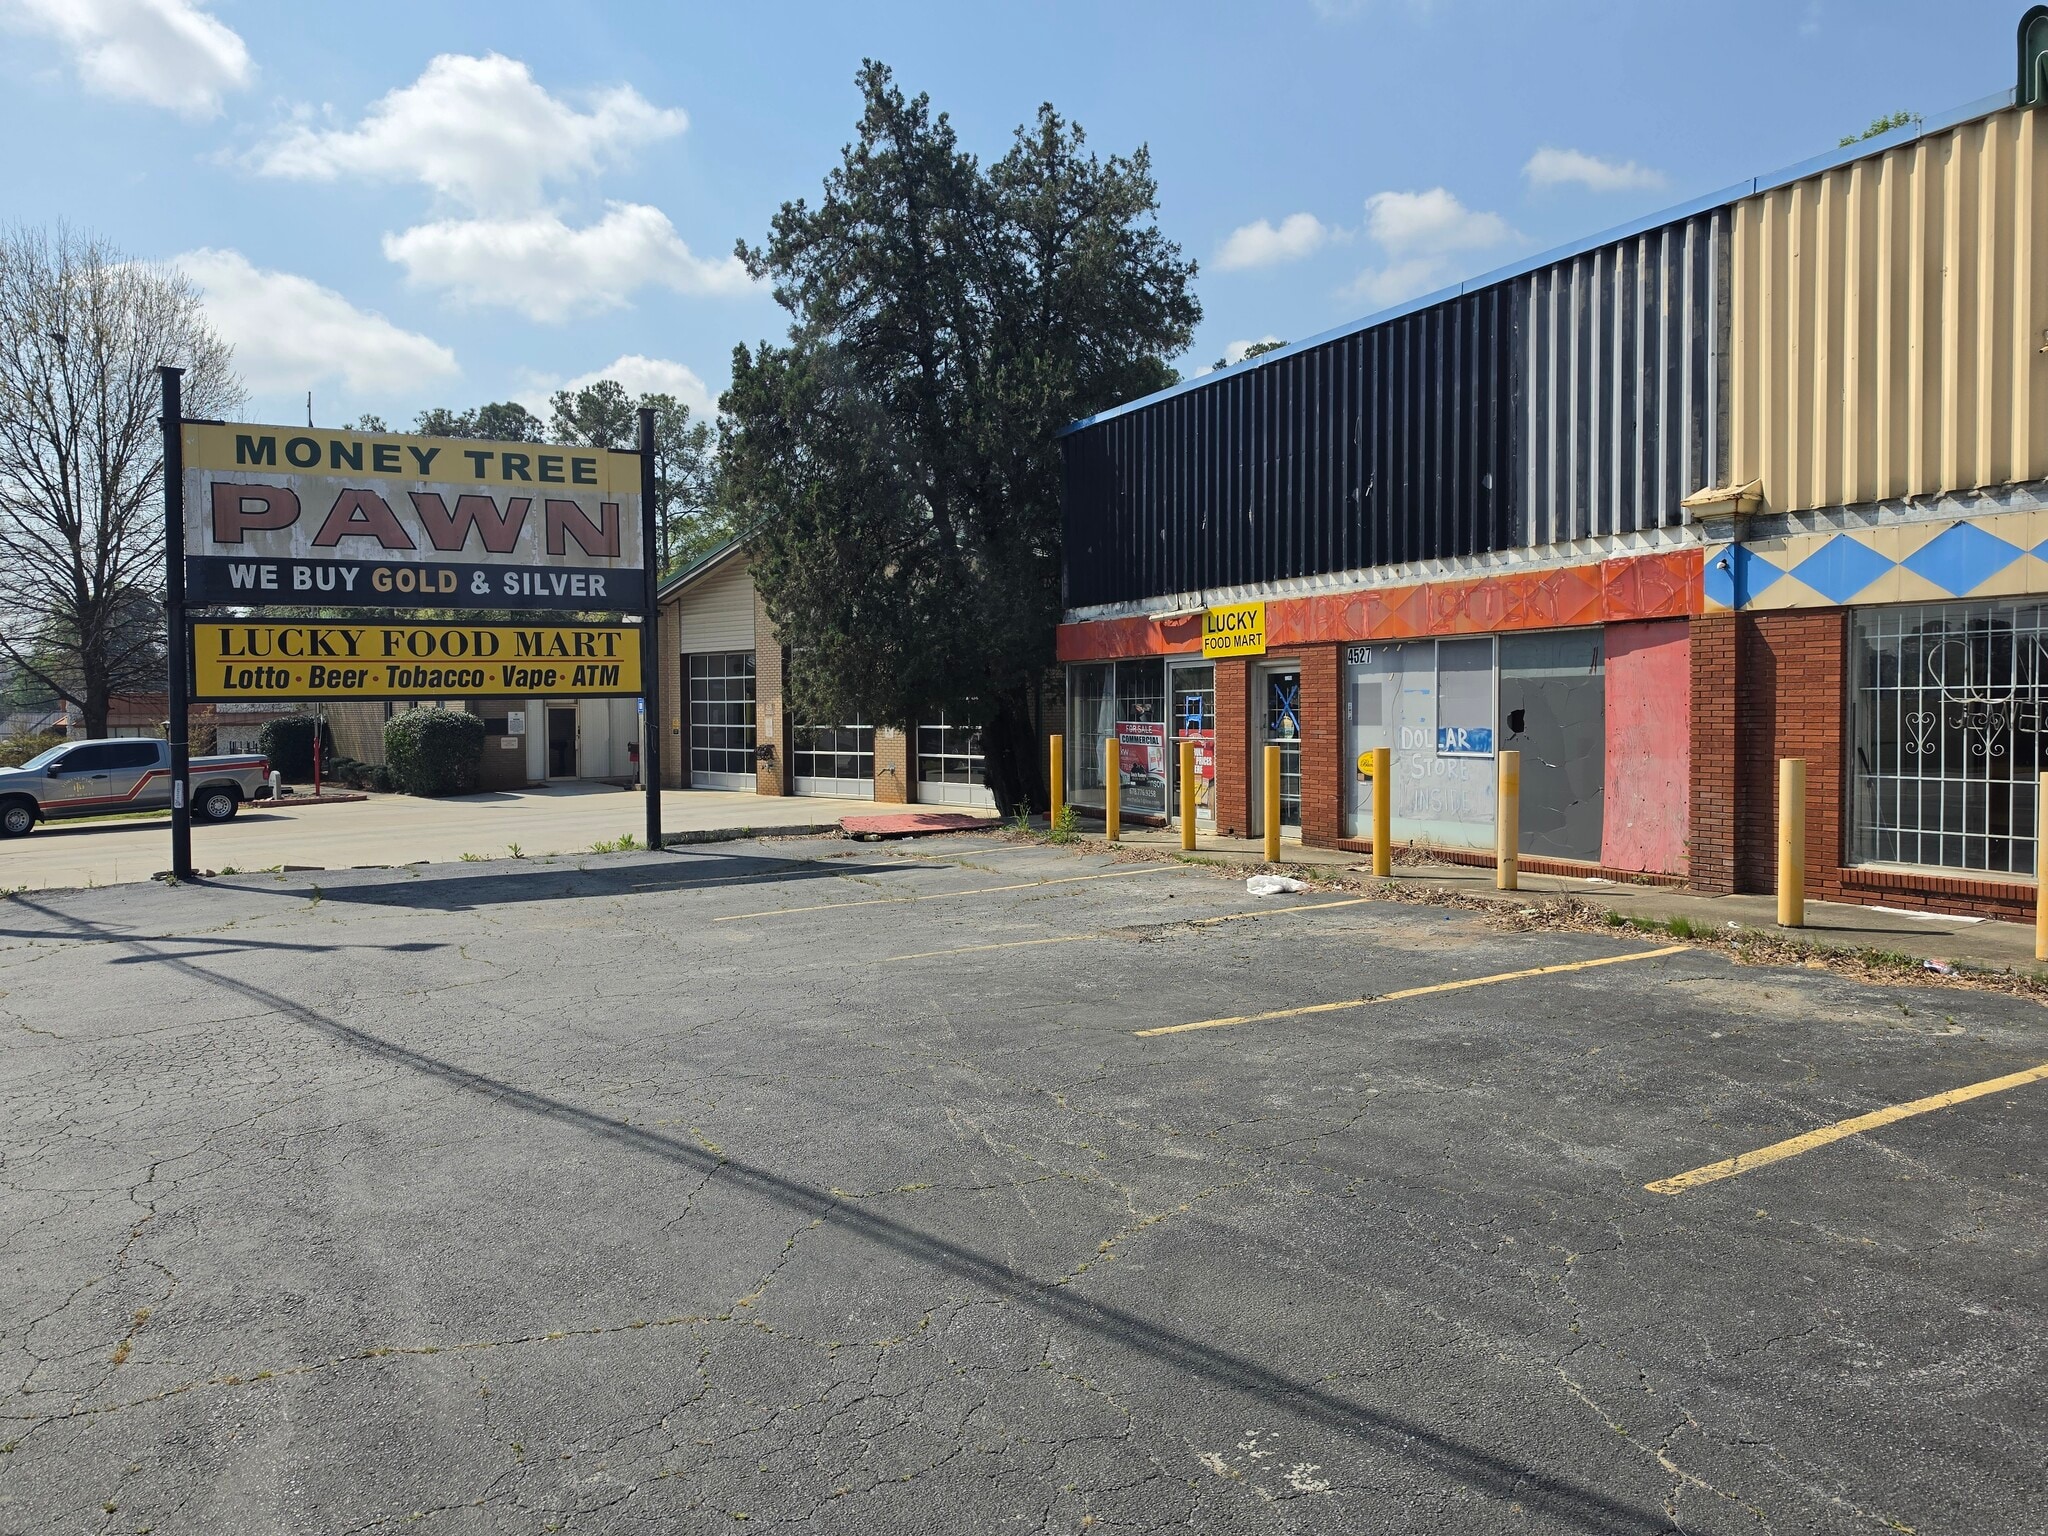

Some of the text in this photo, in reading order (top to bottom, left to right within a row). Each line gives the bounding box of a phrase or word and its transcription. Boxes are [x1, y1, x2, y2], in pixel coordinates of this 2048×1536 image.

[236, 435, 598, 485] MONEY TREE
[210, 481, 621, 558] PAWN
[228, 564, 608, 598] WE BUY GOLD & SILVER
[1208, 610, 1258, 635] LUCKY
[218, 628, 622, 659] LUCKY FOOD MART
[1205, 632, 1264, 651] FOOD MART
[1348, 647, 1371, 665] 4527
[224, 665, 620, 691] Lotto Beer Tobacco Vape ATM
[1121, 735, 1160, 745] COMMERCIAL
[1125, 724, 1153, 734] FOR SALE
